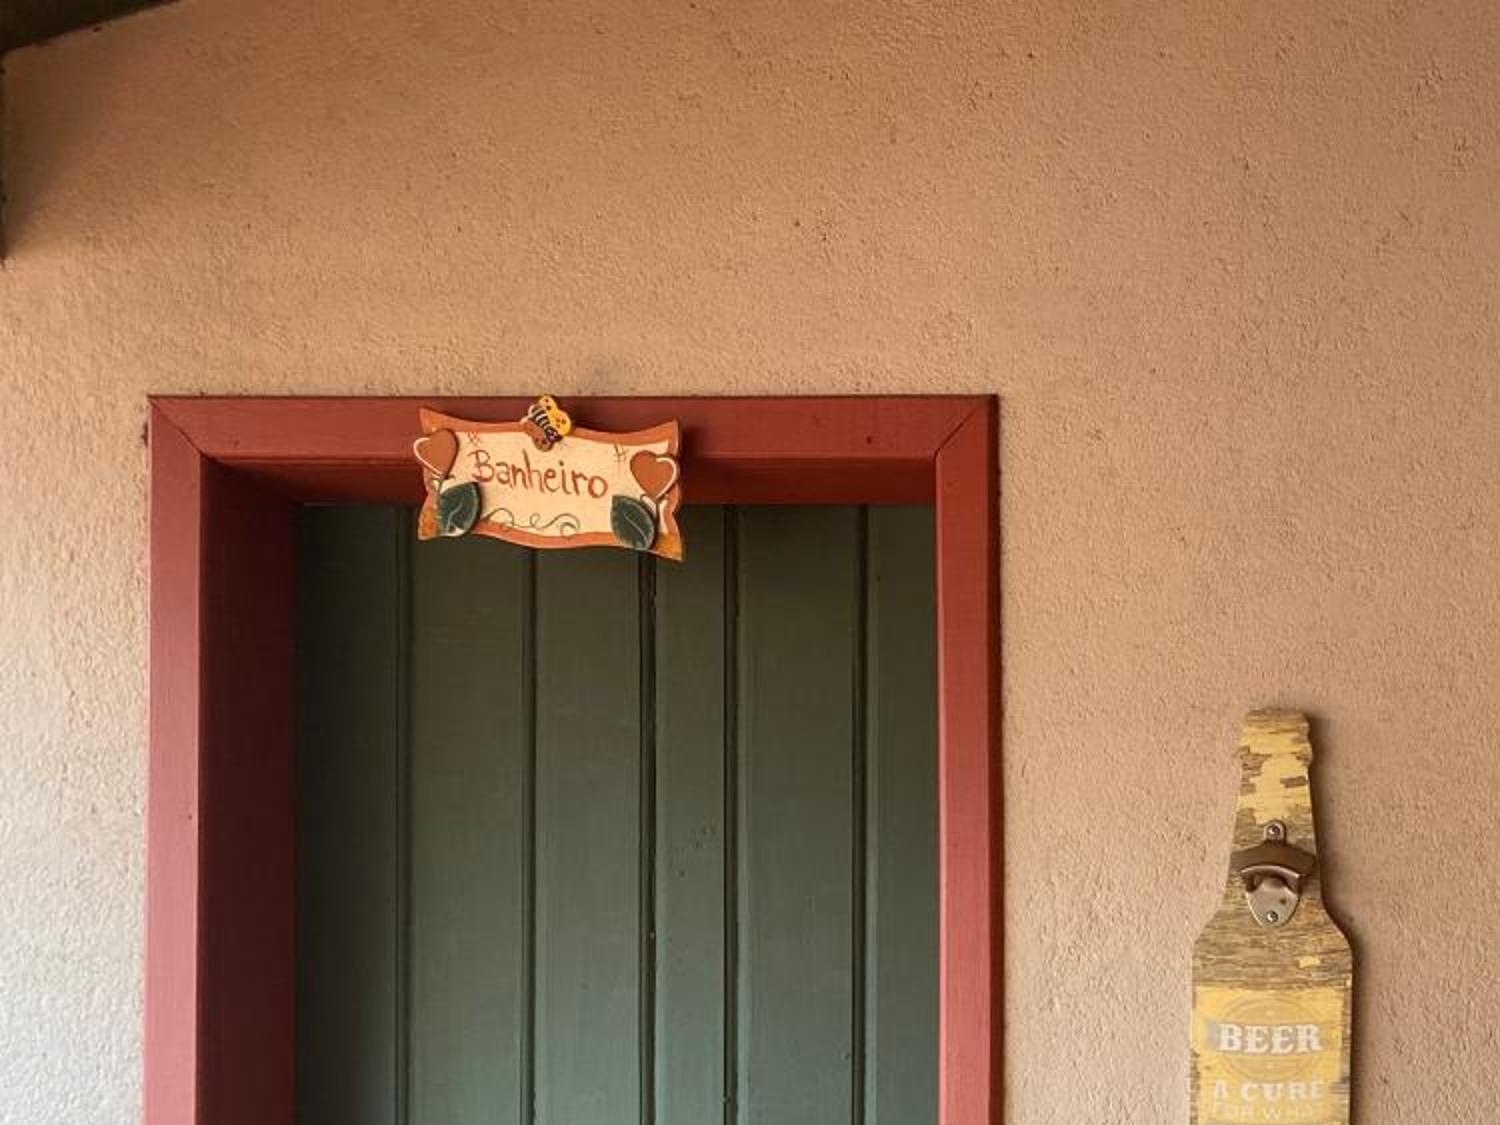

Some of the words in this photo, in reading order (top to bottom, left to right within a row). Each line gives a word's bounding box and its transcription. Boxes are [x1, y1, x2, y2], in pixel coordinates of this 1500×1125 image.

[467, 449, 609, 498] Banheiro
[1218, 1023, 1323, 1055] BEER
[1240, 1081, 1325, 1102] CURE
